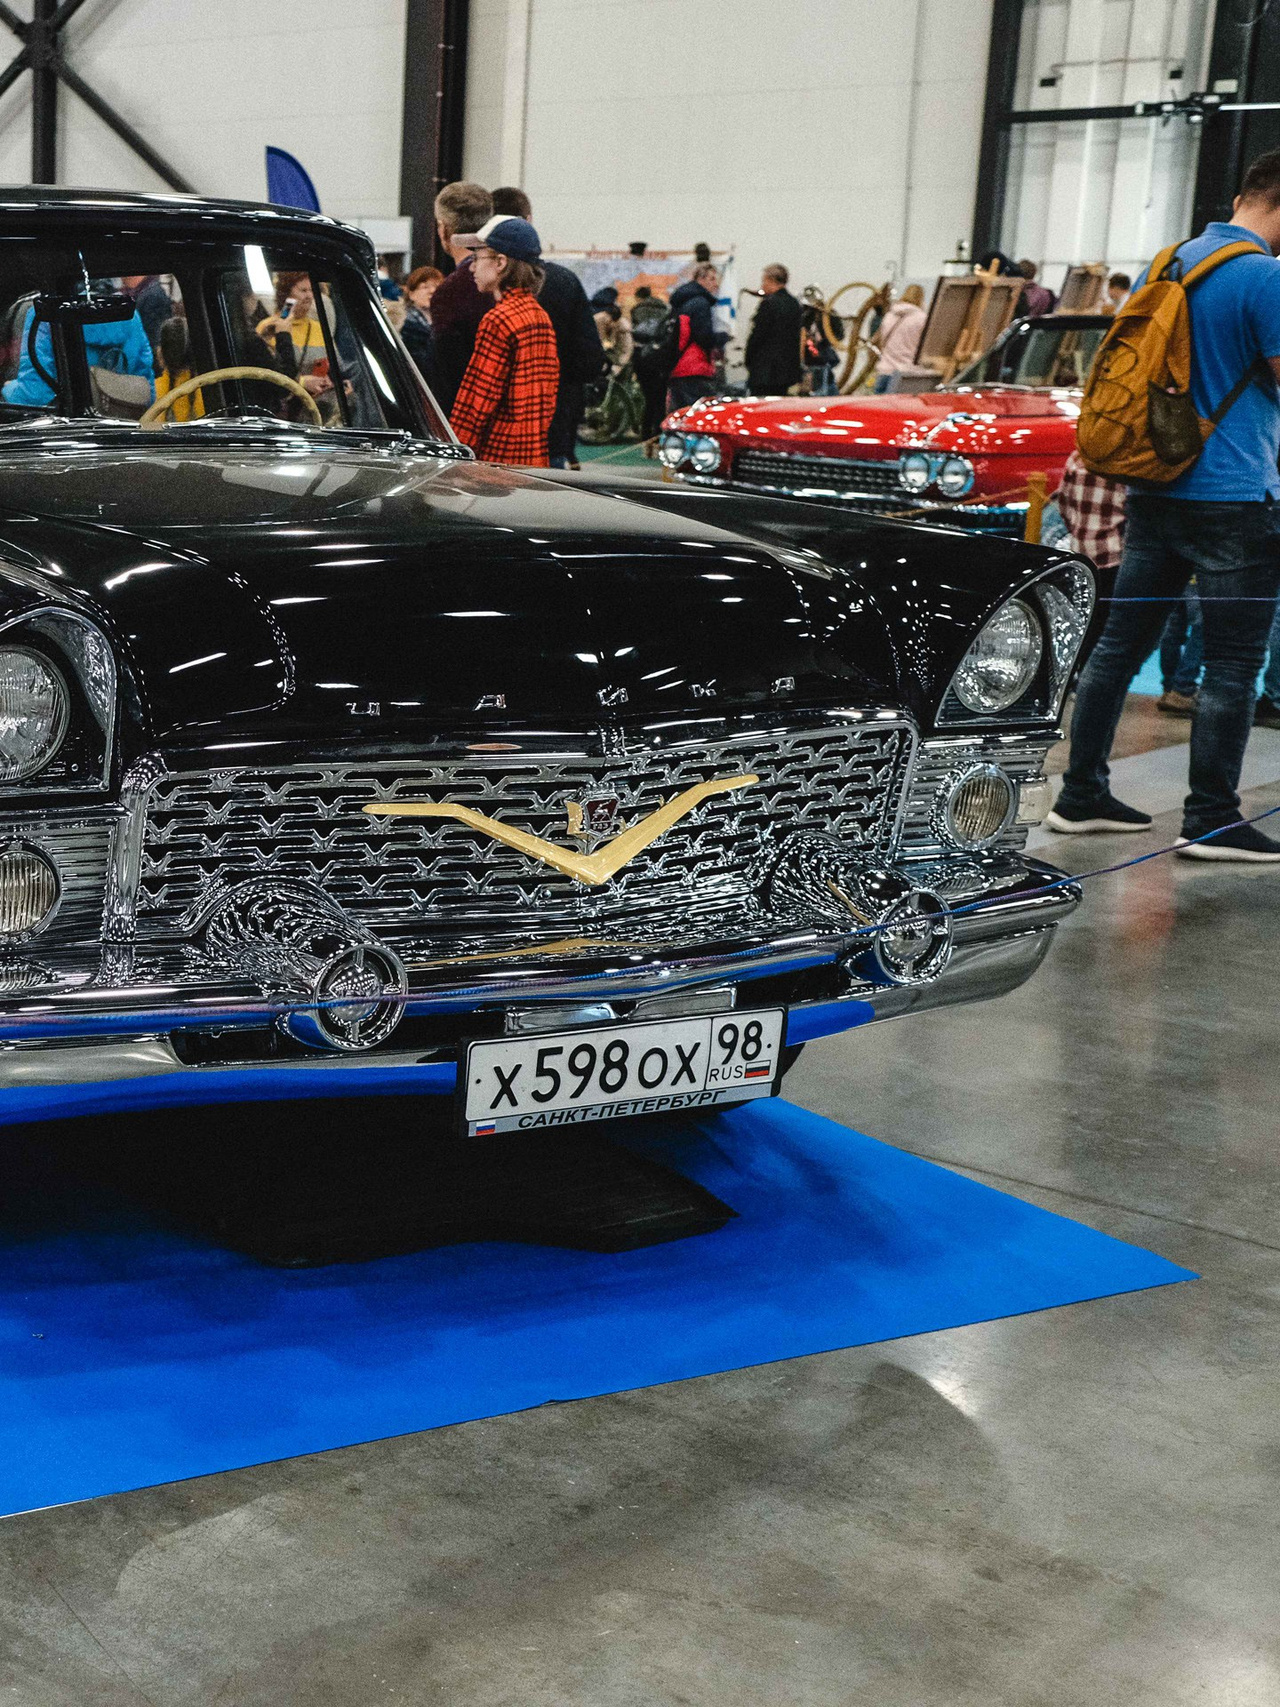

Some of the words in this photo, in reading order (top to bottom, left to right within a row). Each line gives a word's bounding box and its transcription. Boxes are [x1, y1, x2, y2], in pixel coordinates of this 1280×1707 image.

[717, 1020, 763, 1065] 98
[708, 1065, 744, 1082] RUS
[517, 1090, 728, 1129] САНКТ-ПЕТЕРБУРГ
